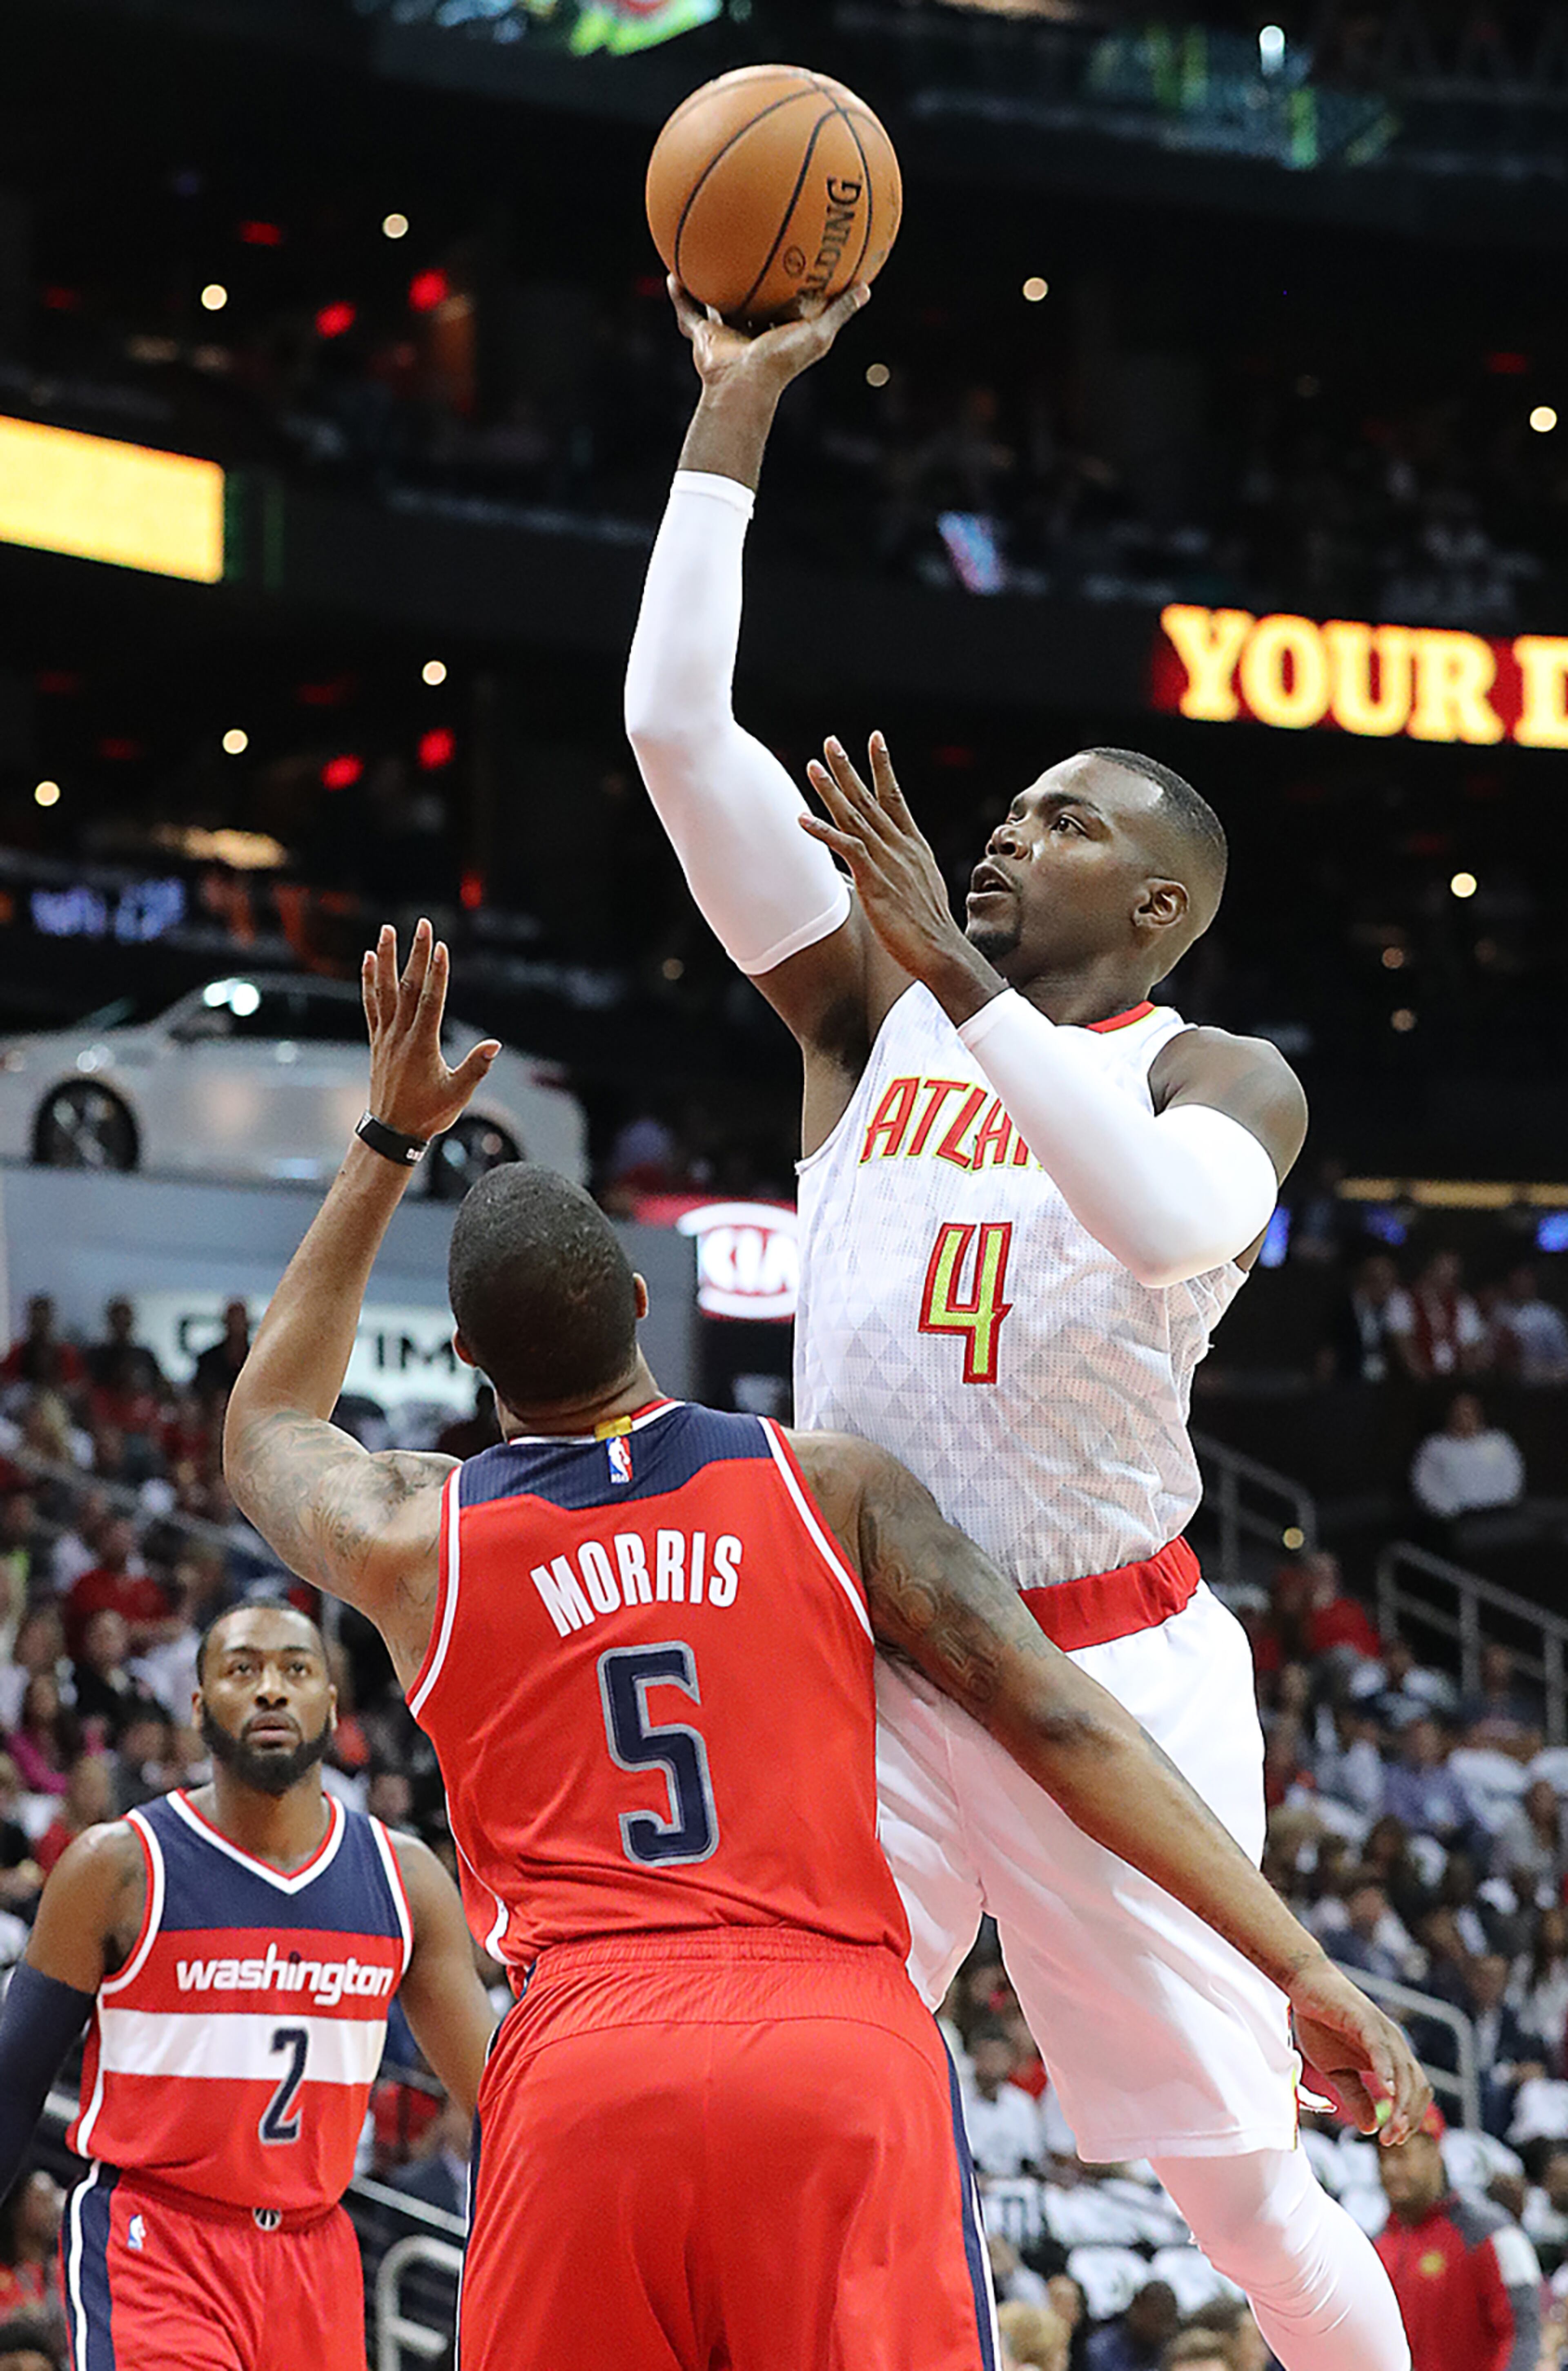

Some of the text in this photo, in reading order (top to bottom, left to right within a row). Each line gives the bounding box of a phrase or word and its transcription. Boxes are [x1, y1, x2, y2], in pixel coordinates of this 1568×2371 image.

[1160, 603, 1505, 745] YOUR
[918, 1221, 1013, 1385] 4
[530, 1529, 742, 1637] MORRIS
[597, 1641, 719, 1867] 5
[176, 1942, 394, 2005] washington
[258, 2028, 308, 2145] 2
